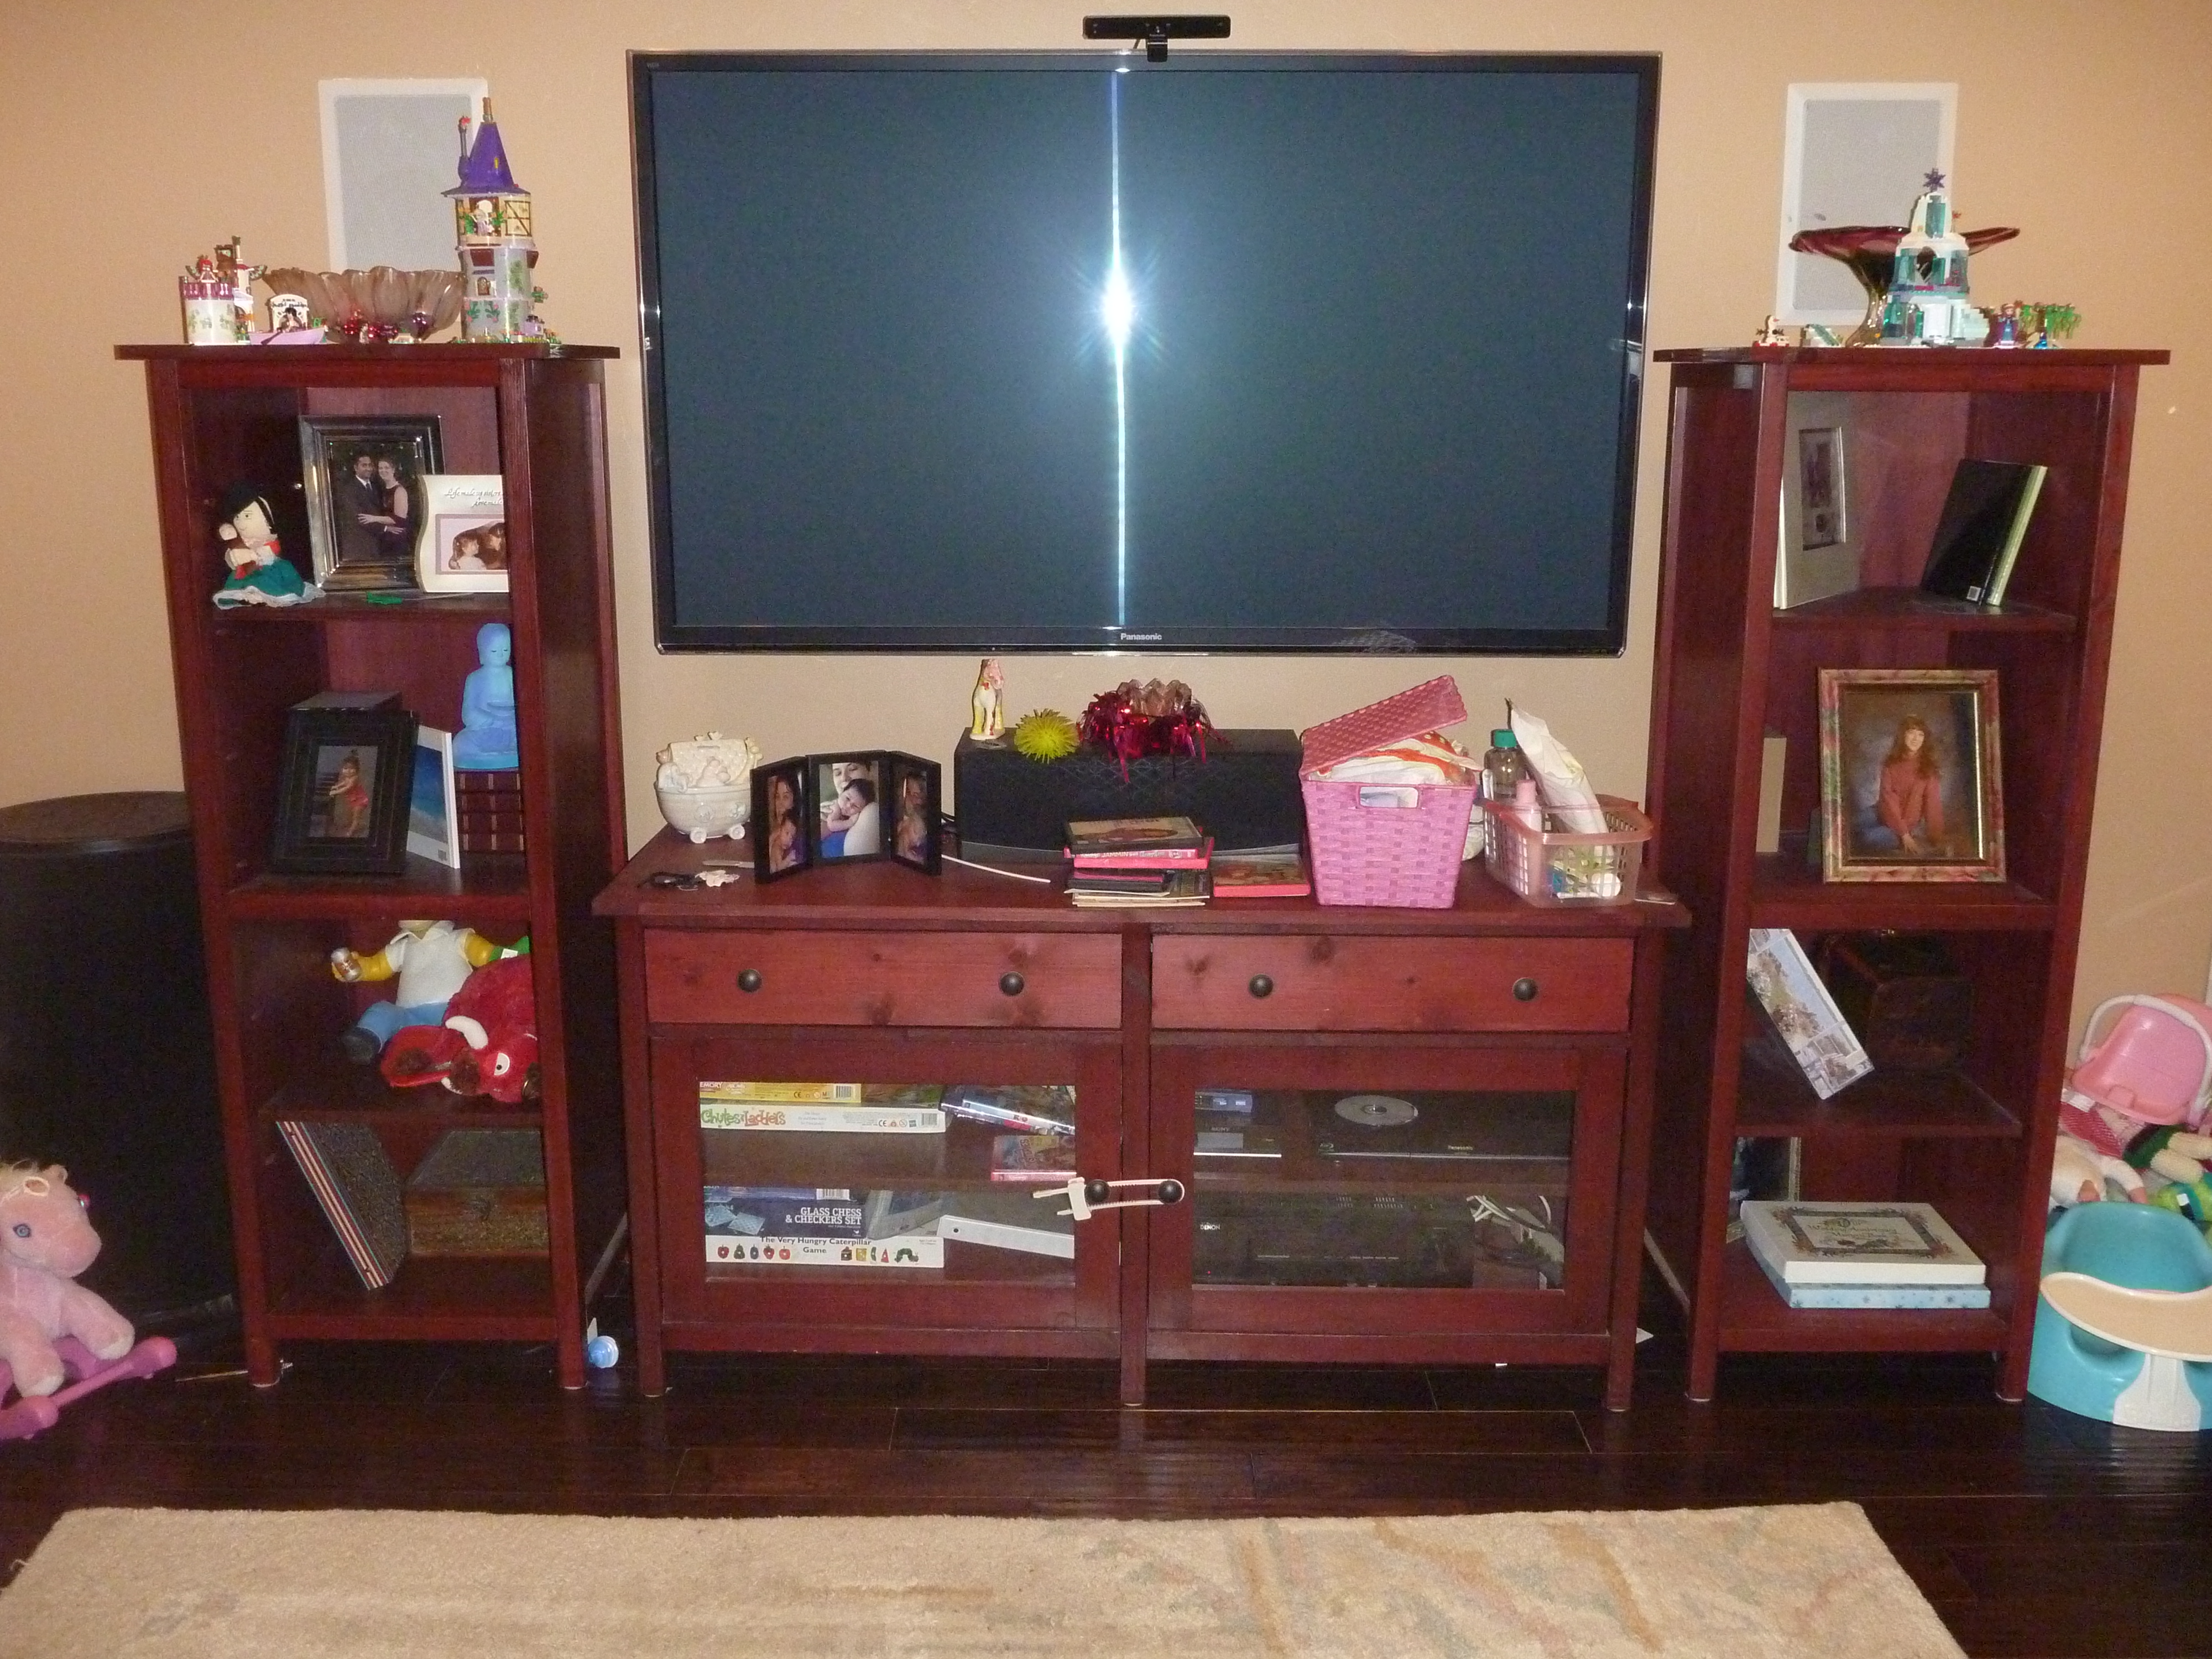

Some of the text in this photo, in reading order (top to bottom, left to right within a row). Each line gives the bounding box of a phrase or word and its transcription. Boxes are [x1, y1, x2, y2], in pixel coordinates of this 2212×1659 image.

[701, 1108, 740, 1125] Chutes
[743, 1110, 786, 1126] Ladders
[801, 1207, 862, 1217] GLASS CHESS
[785, 1215, 862, 1225] & CHECKERS SET
[777, 1237, 795, 1245] Very
